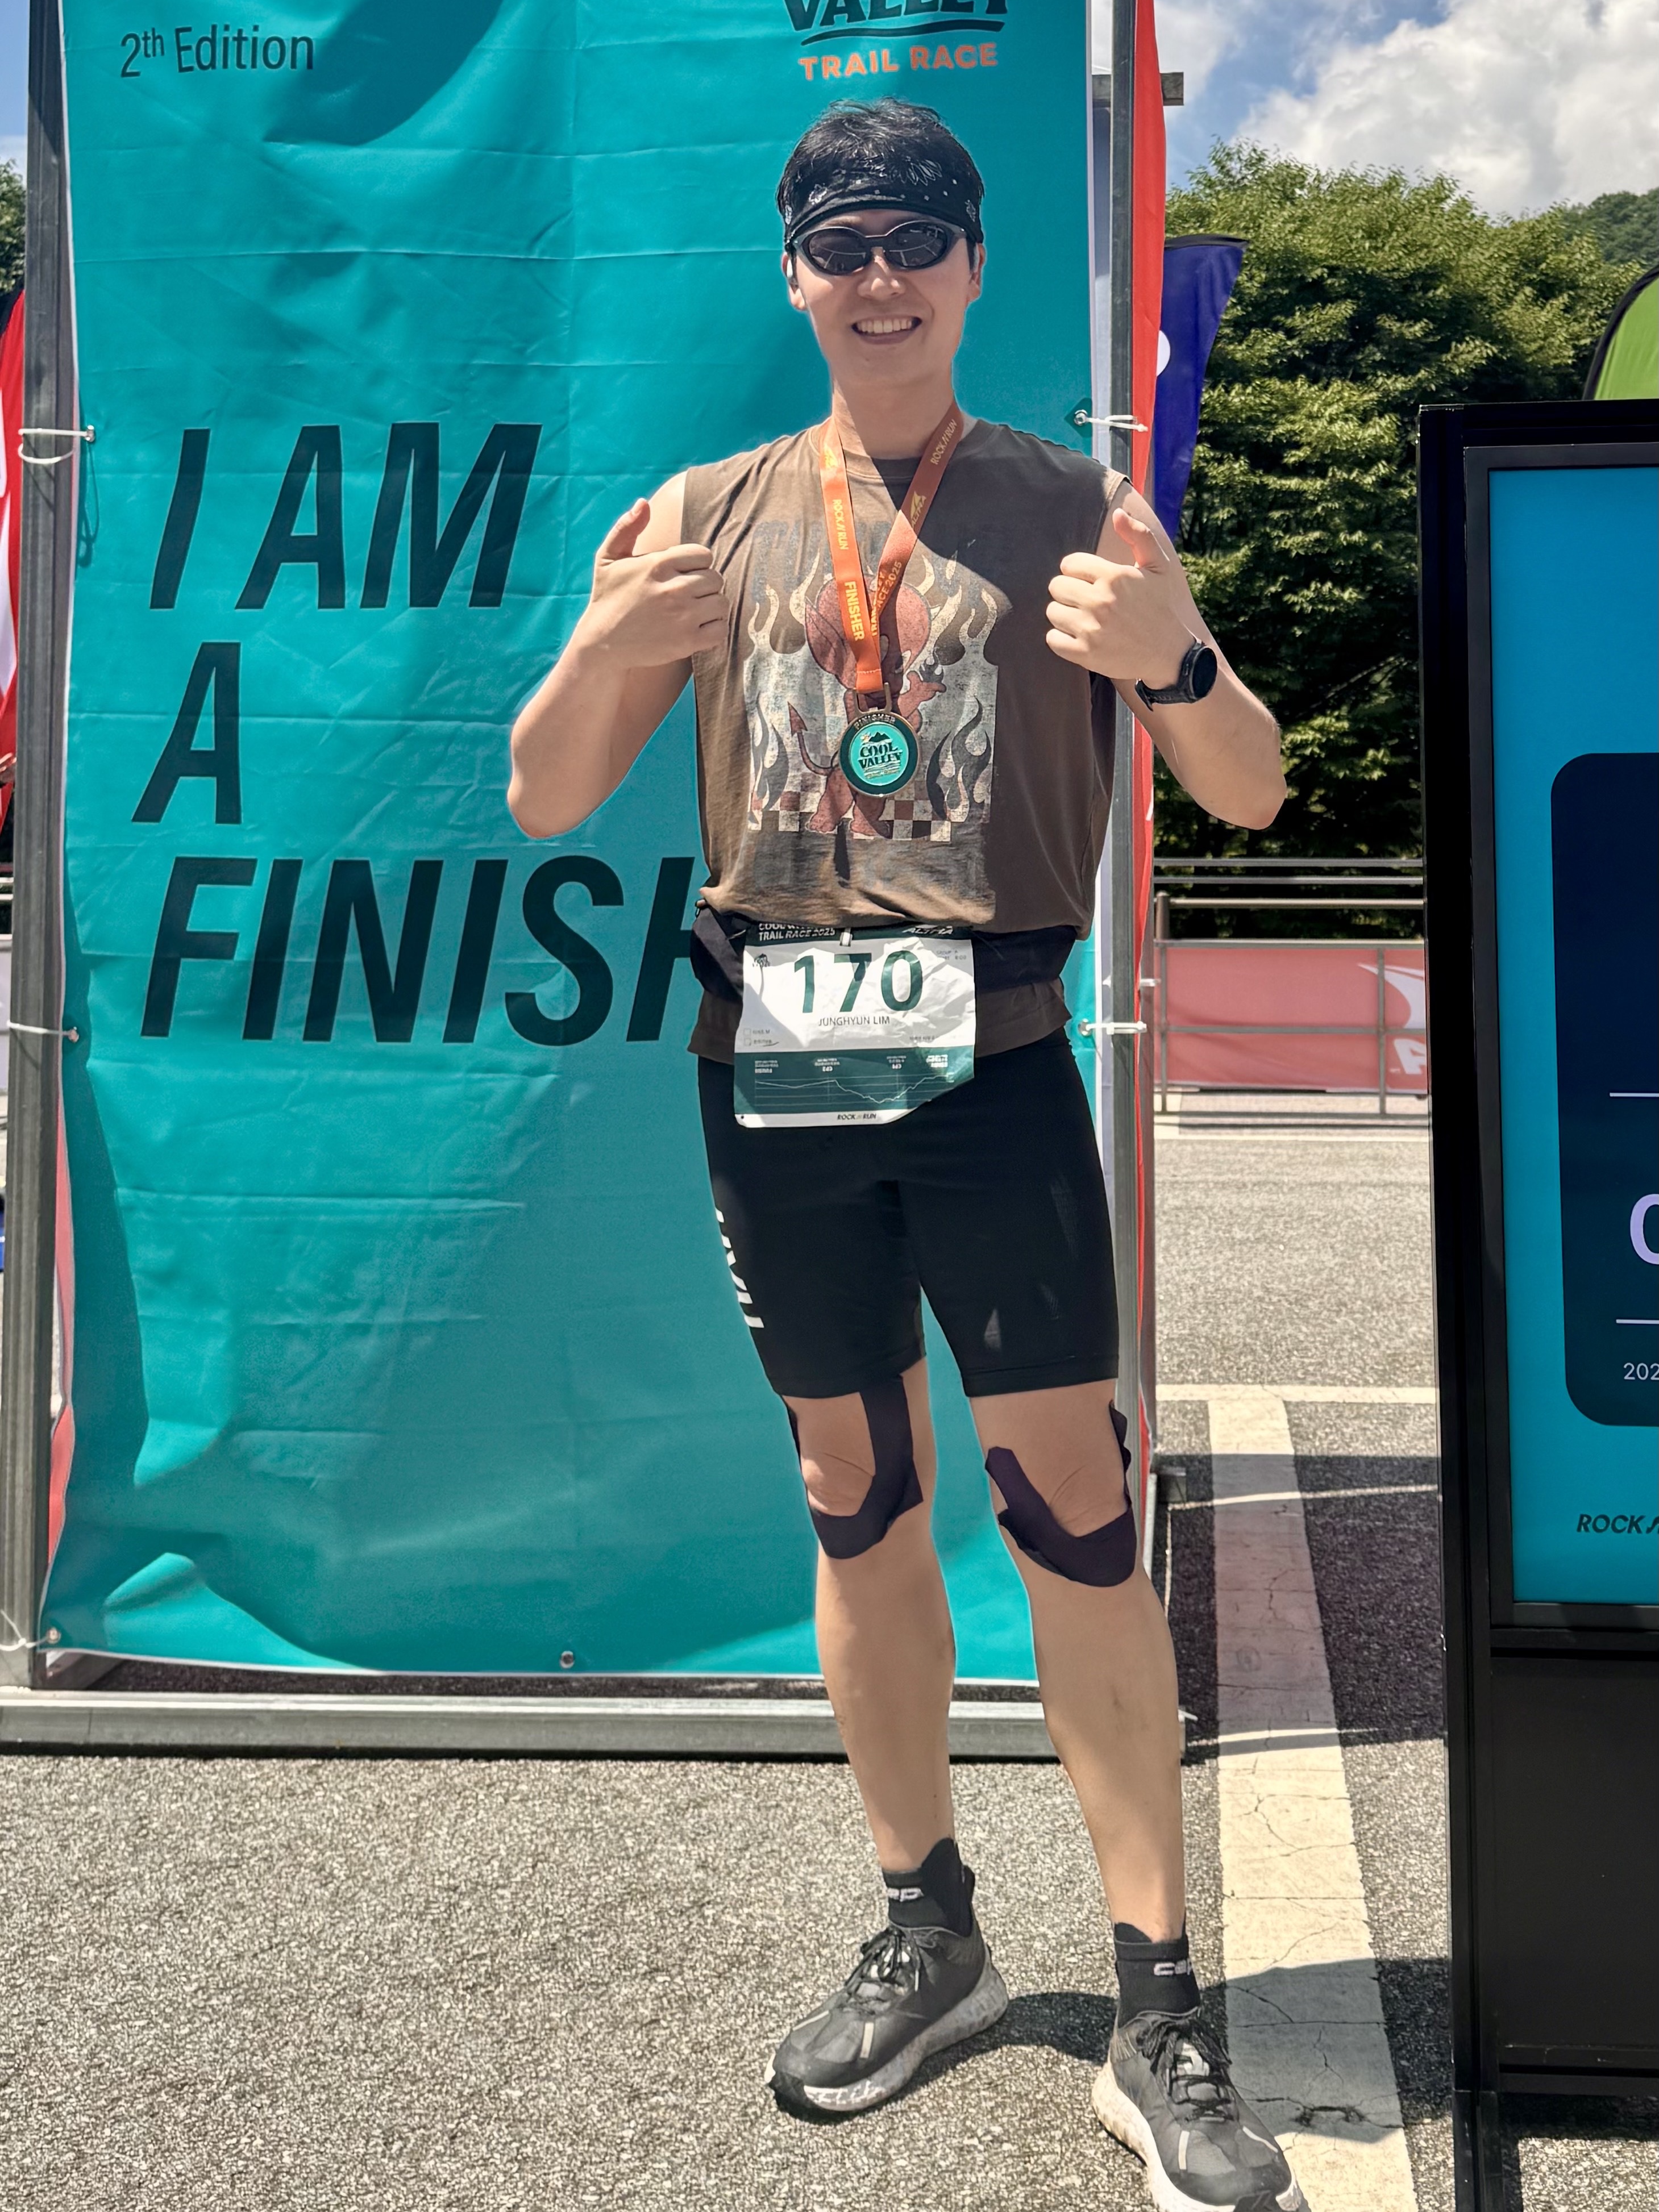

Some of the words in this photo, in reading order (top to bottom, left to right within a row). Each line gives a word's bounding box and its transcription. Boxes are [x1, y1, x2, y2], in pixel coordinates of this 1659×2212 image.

[174, 24, 314, 73] Edition
[798, 49, 899, 81] TRAIL
[910, 42, 997, 70] RACE
[149, 427, 211, 610] I
[235, 422, 543, 610] AM
[885, 561, 903, 588] 2025
[845, 581, 865, 641] FINISHER
[131, 641, 242, 824] A
[858, 752, 903, 769] VALLEY
[860, 742, 899, 757] COOL
[759, 930, 784, 942] TRAIL
[785, 930, 810, 939] RACE
[793, 949, 924, 1014] 170
[818, 1016, 870, 1026] JUNGHYUN
[874, 1015, 890, 1024] LIM
[1576, 1513, 1646, 1534] ROCK
